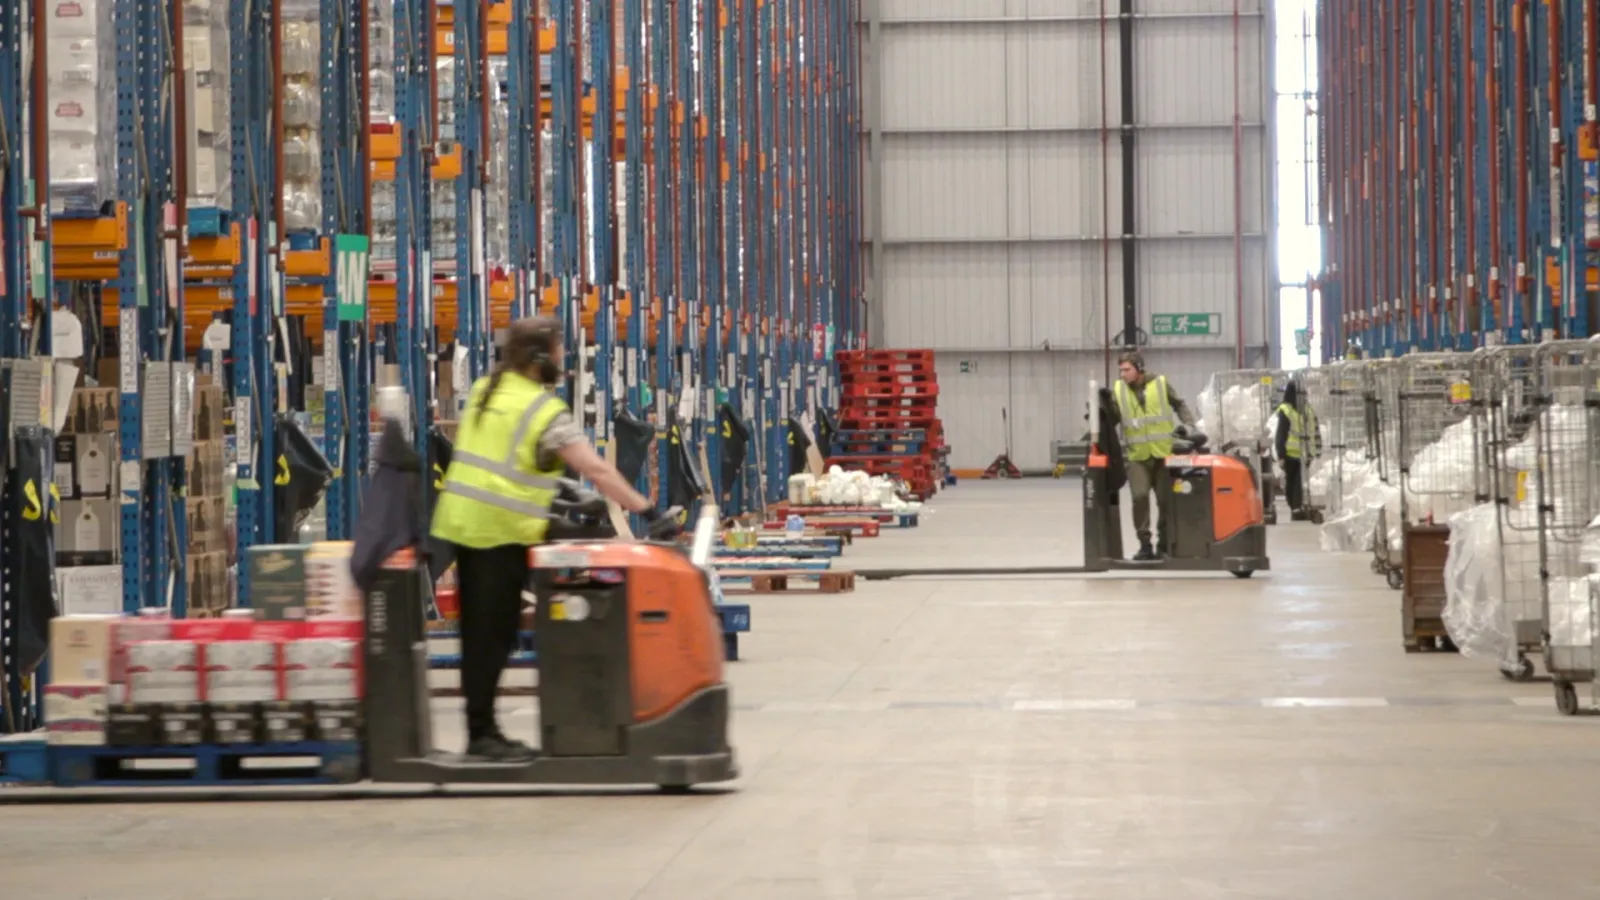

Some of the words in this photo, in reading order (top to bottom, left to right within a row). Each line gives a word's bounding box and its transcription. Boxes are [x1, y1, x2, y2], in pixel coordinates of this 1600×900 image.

[336, 251, 366, 304] AN
[1154, 316, 1172, 324] FIRE
[1154, 325, 1172, 333] EXIT
